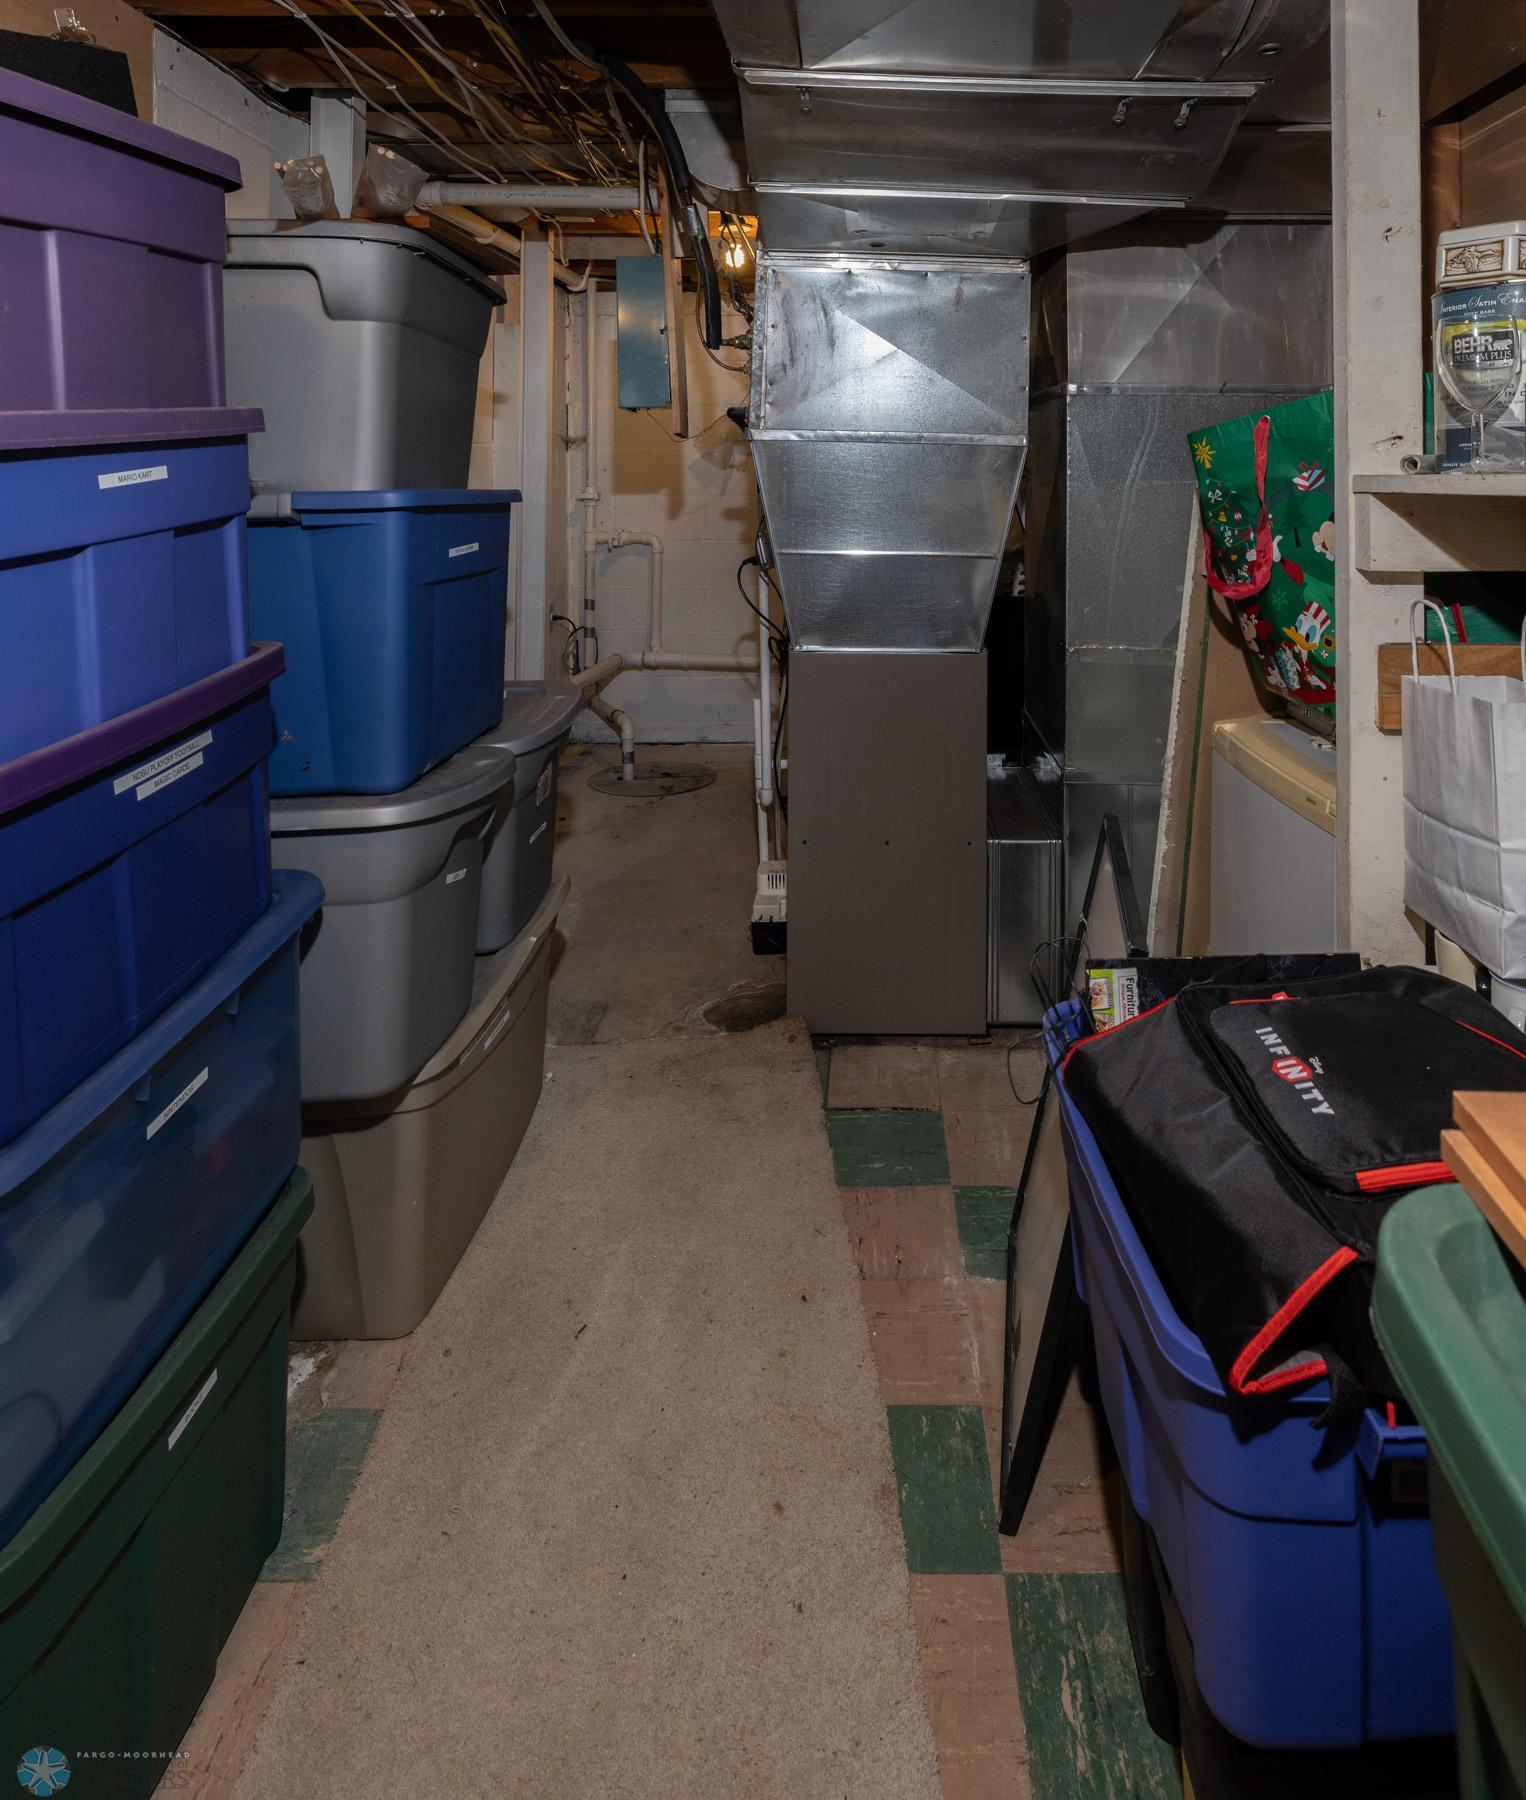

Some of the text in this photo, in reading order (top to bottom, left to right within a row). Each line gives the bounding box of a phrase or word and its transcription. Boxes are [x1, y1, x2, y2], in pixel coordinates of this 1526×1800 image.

[1497, 293, 1526, 305] ENA
[1454, 335, 1493, 354] BEHR
[1490, 350, 1512, 360] PLUS
[117, 470, 152, 483] MARIO KART
[132, 741, 200, 782] NDSU PLAYOFF FOOTBALL
[153, 762, 191, 788] MAGIC CARDS
[1126, 977, 1135, 1016] Furnitur
[1255, 1026, 1335, 1115] INFINITY
